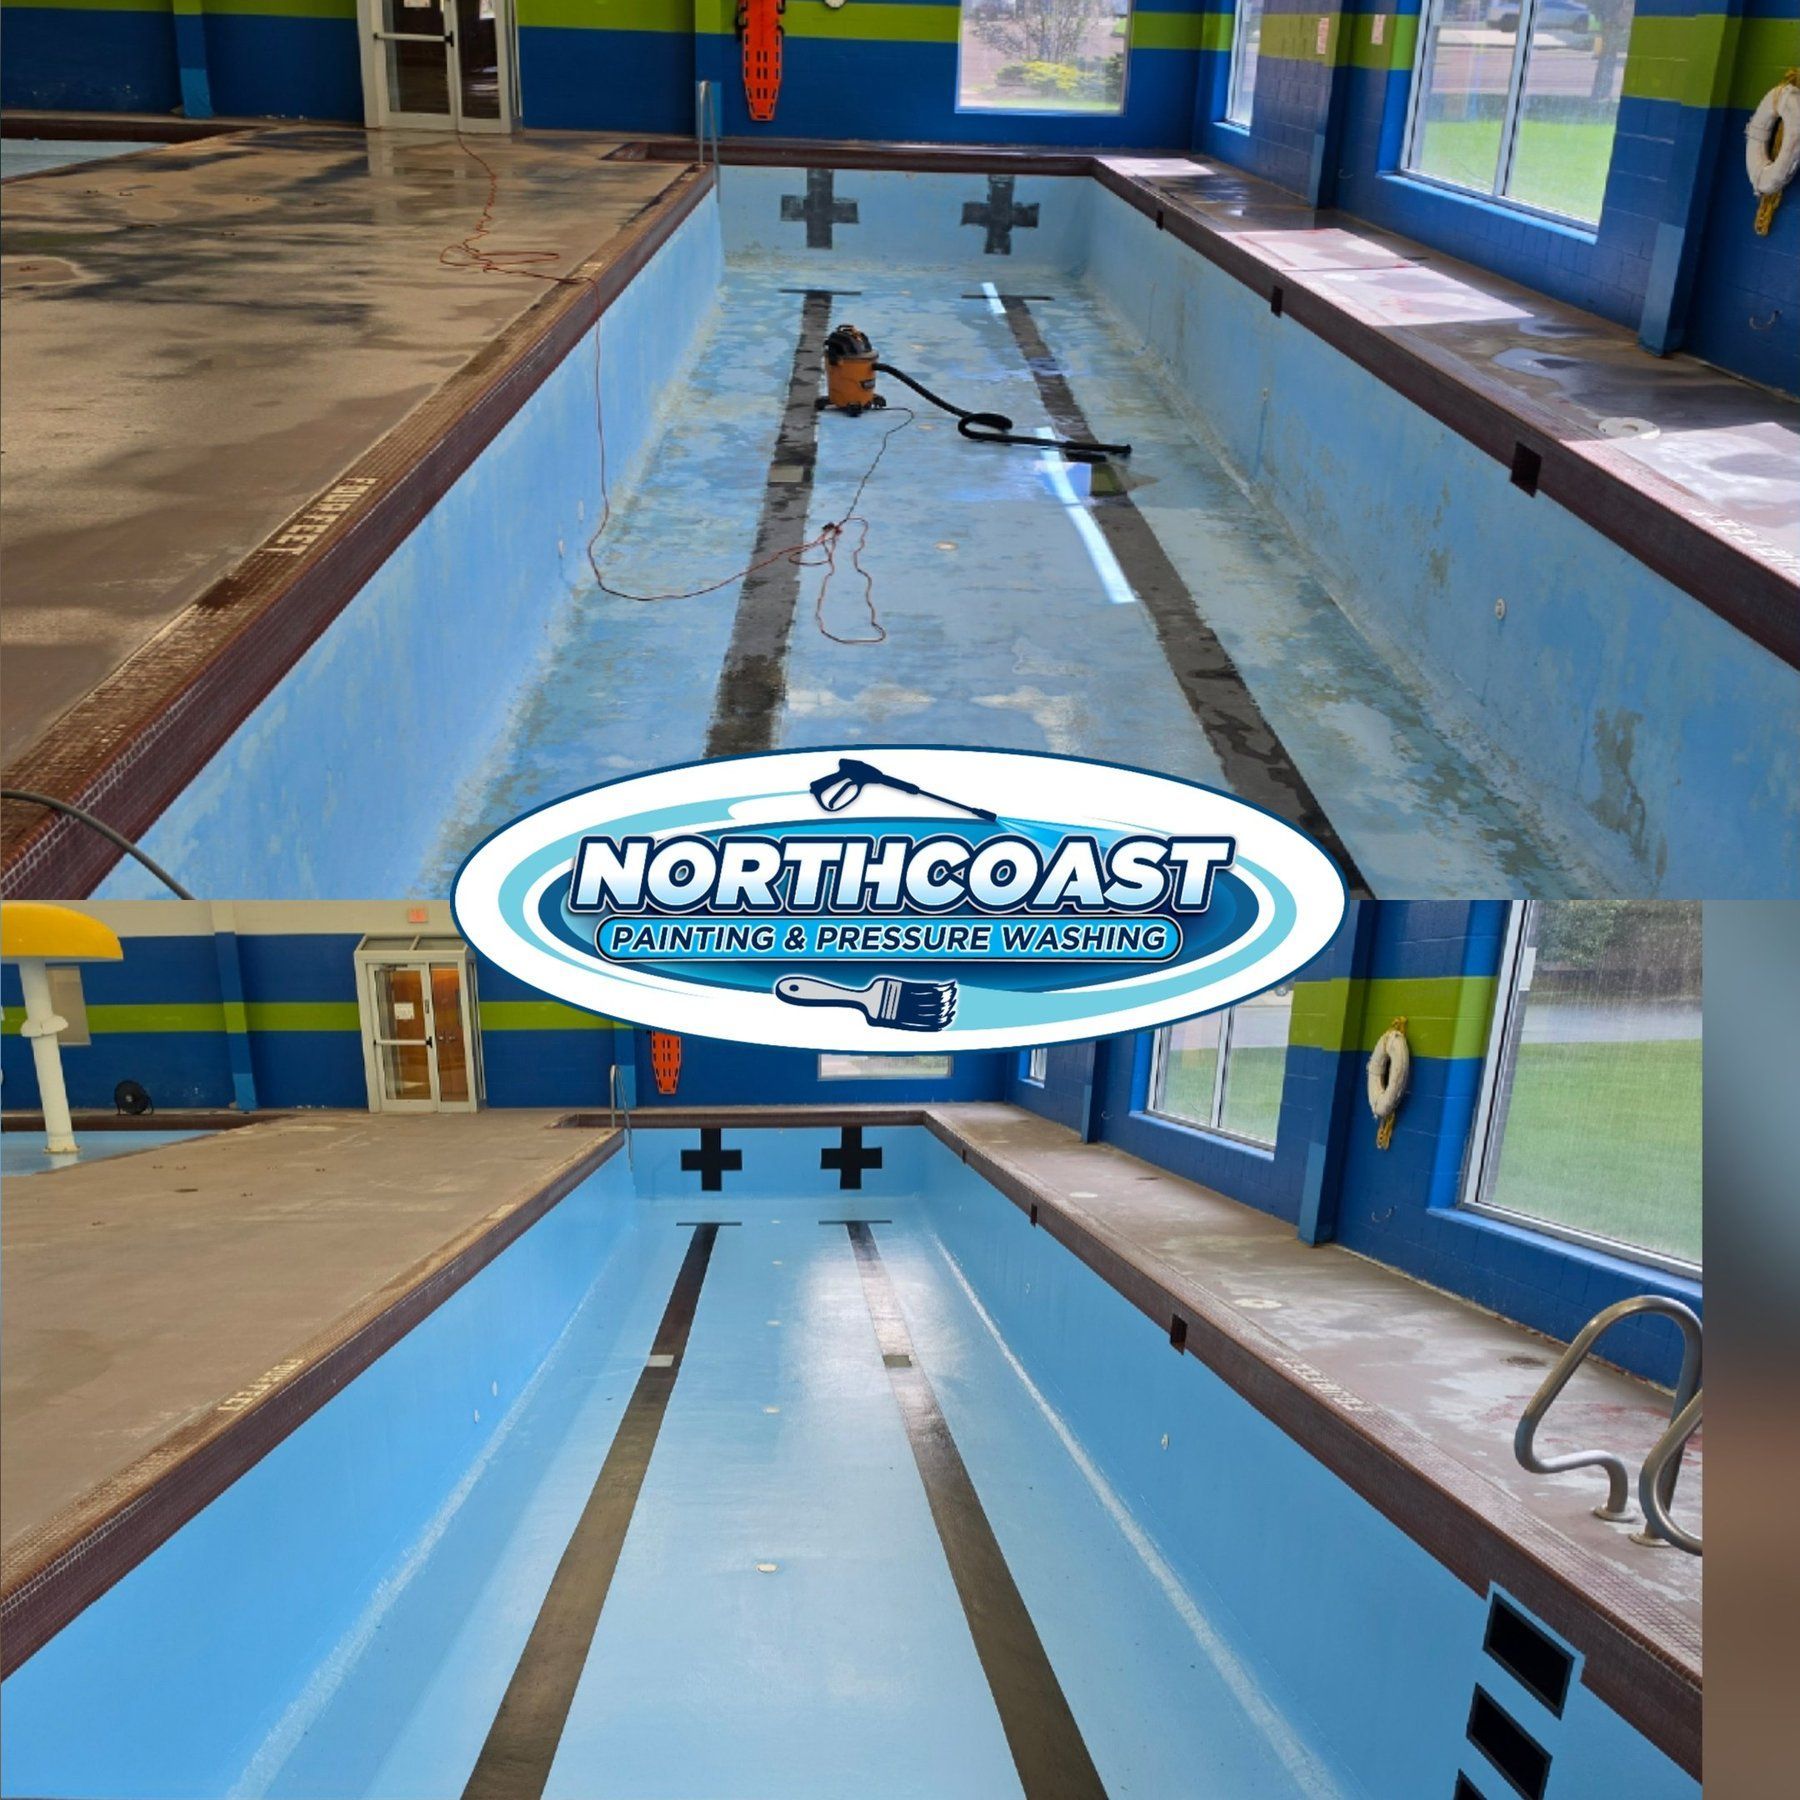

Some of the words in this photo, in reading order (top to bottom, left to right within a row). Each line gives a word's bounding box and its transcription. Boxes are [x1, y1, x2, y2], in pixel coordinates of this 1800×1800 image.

[310, 477, 379, 513] FOUR
[260, 514, 341, 555] FEET
[216, 1384, 272, 1411] FEET
